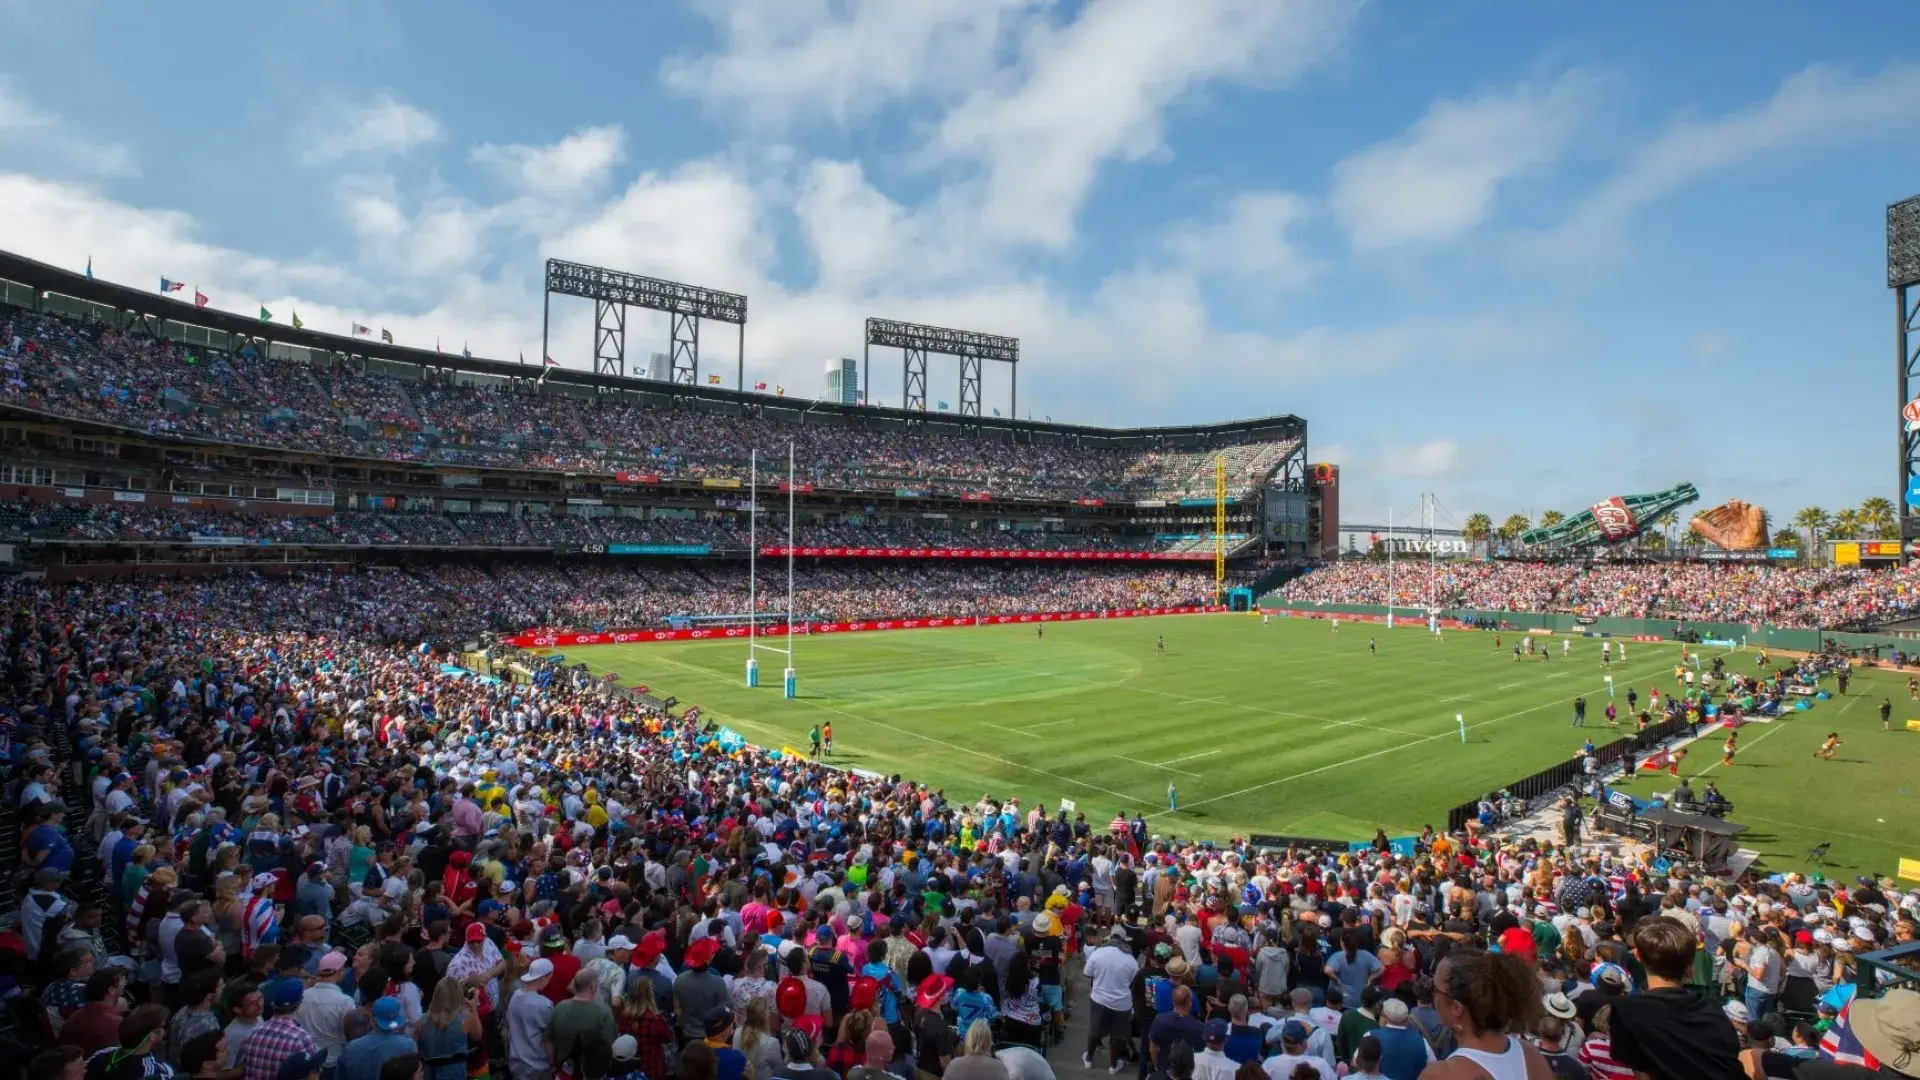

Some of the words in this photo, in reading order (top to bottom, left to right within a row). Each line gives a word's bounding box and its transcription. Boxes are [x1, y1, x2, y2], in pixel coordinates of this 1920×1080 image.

[582, 543, 604, 553] 4:50
[1384, 539, 1468, 552] nuveen
[1133, 821, 1142, 833] 7
[961, 1003, 982, 1022] 7
